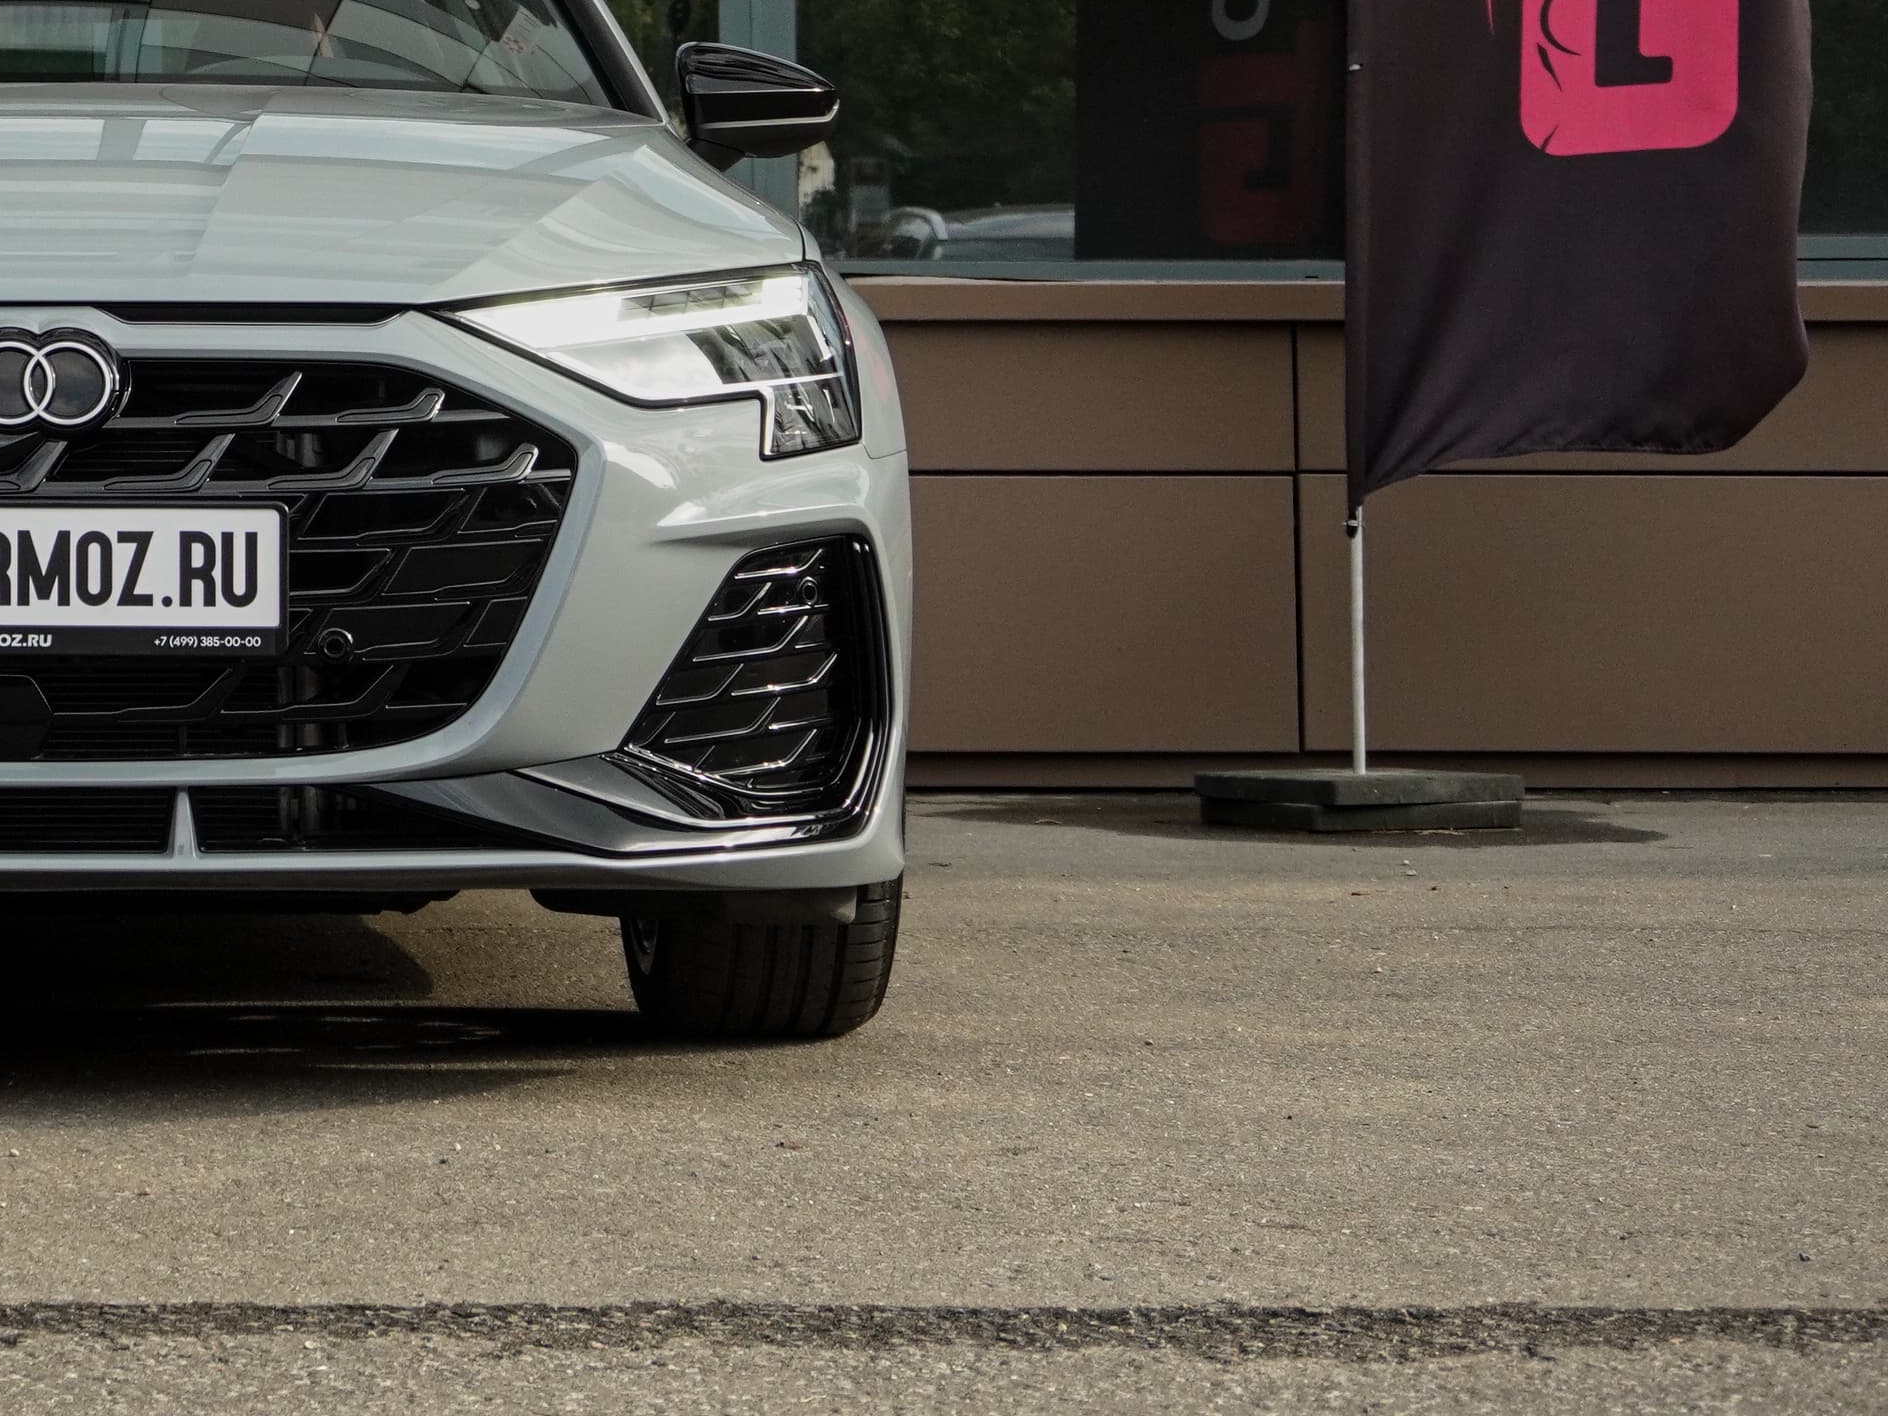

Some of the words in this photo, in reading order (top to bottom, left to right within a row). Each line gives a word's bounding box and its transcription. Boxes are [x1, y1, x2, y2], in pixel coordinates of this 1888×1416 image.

[154, 636, 167, 647] +7
[169, 635, 198, 648] (499)
[200, 636, 261, 647] 385-00-00
